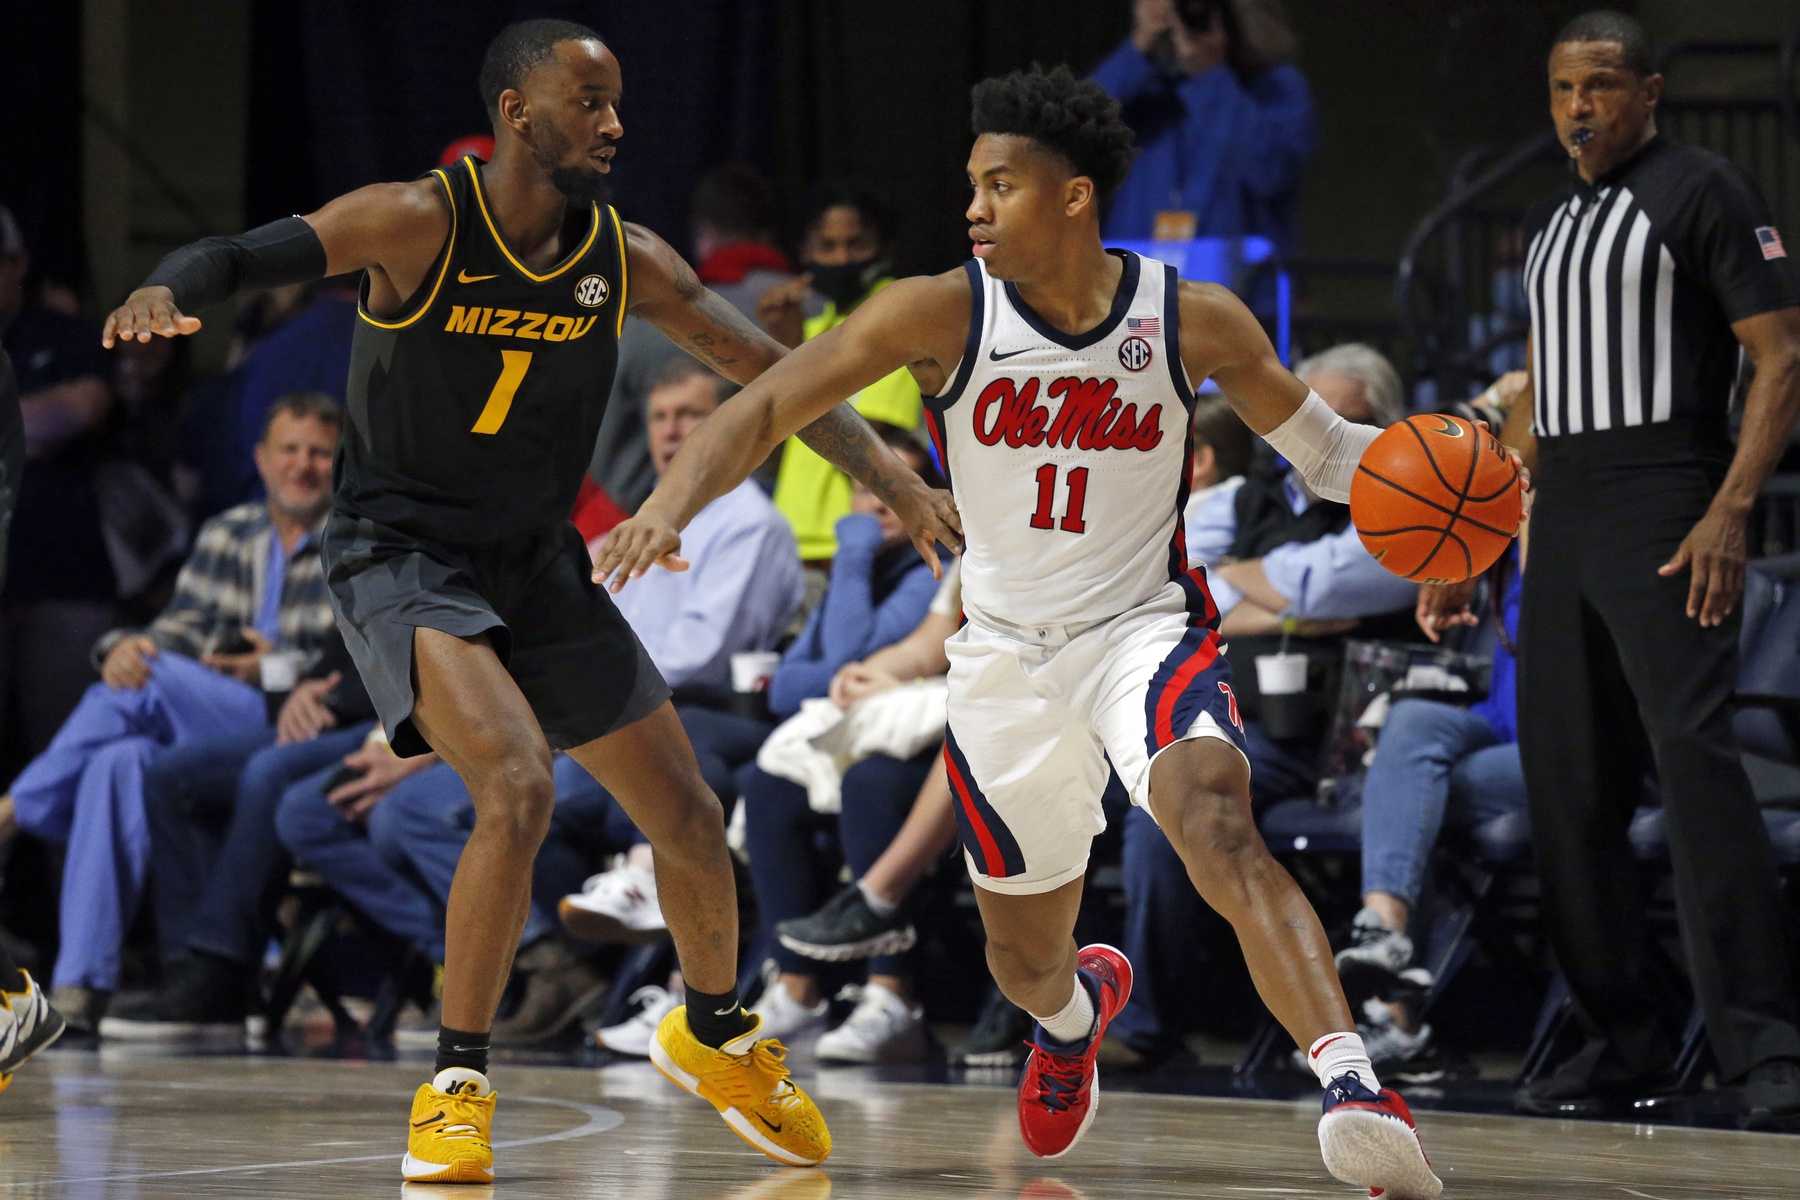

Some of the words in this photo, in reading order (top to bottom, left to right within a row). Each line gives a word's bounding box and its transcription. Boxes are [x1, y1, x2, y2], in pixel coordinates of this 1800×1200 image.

[575, 275, 609, 307] SEC
[444, 304, 598, 342] MIZZOU
[1120, 338, 1150, 370] SEC
[470, 349, 533, 435] 1
[973, 376, 1049, 449] Ole
[1047, 376, 1164, 451] Miss
[1029, 463, 1089, 534] 11
